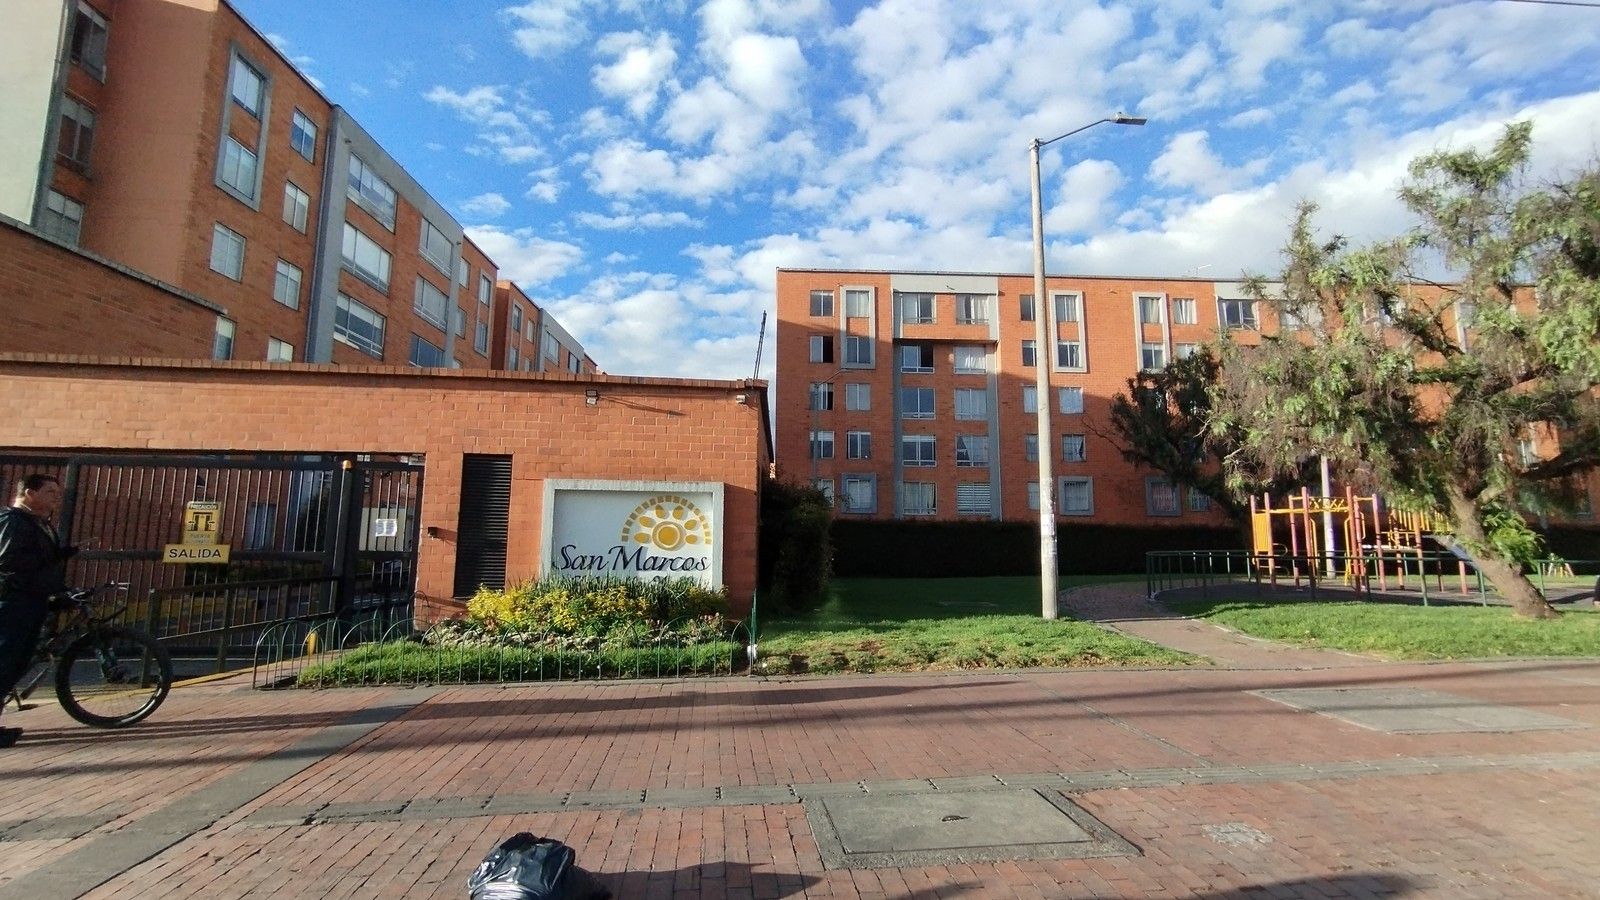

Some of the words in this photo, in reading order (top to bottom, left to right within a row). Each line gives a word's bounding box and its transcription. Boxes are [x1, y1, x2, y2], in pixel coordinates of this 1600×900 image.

[169, 548, 222, 559] SALIDA
[552, 544, 608, 571] San
[609, 545, 710, 572] Marcos
